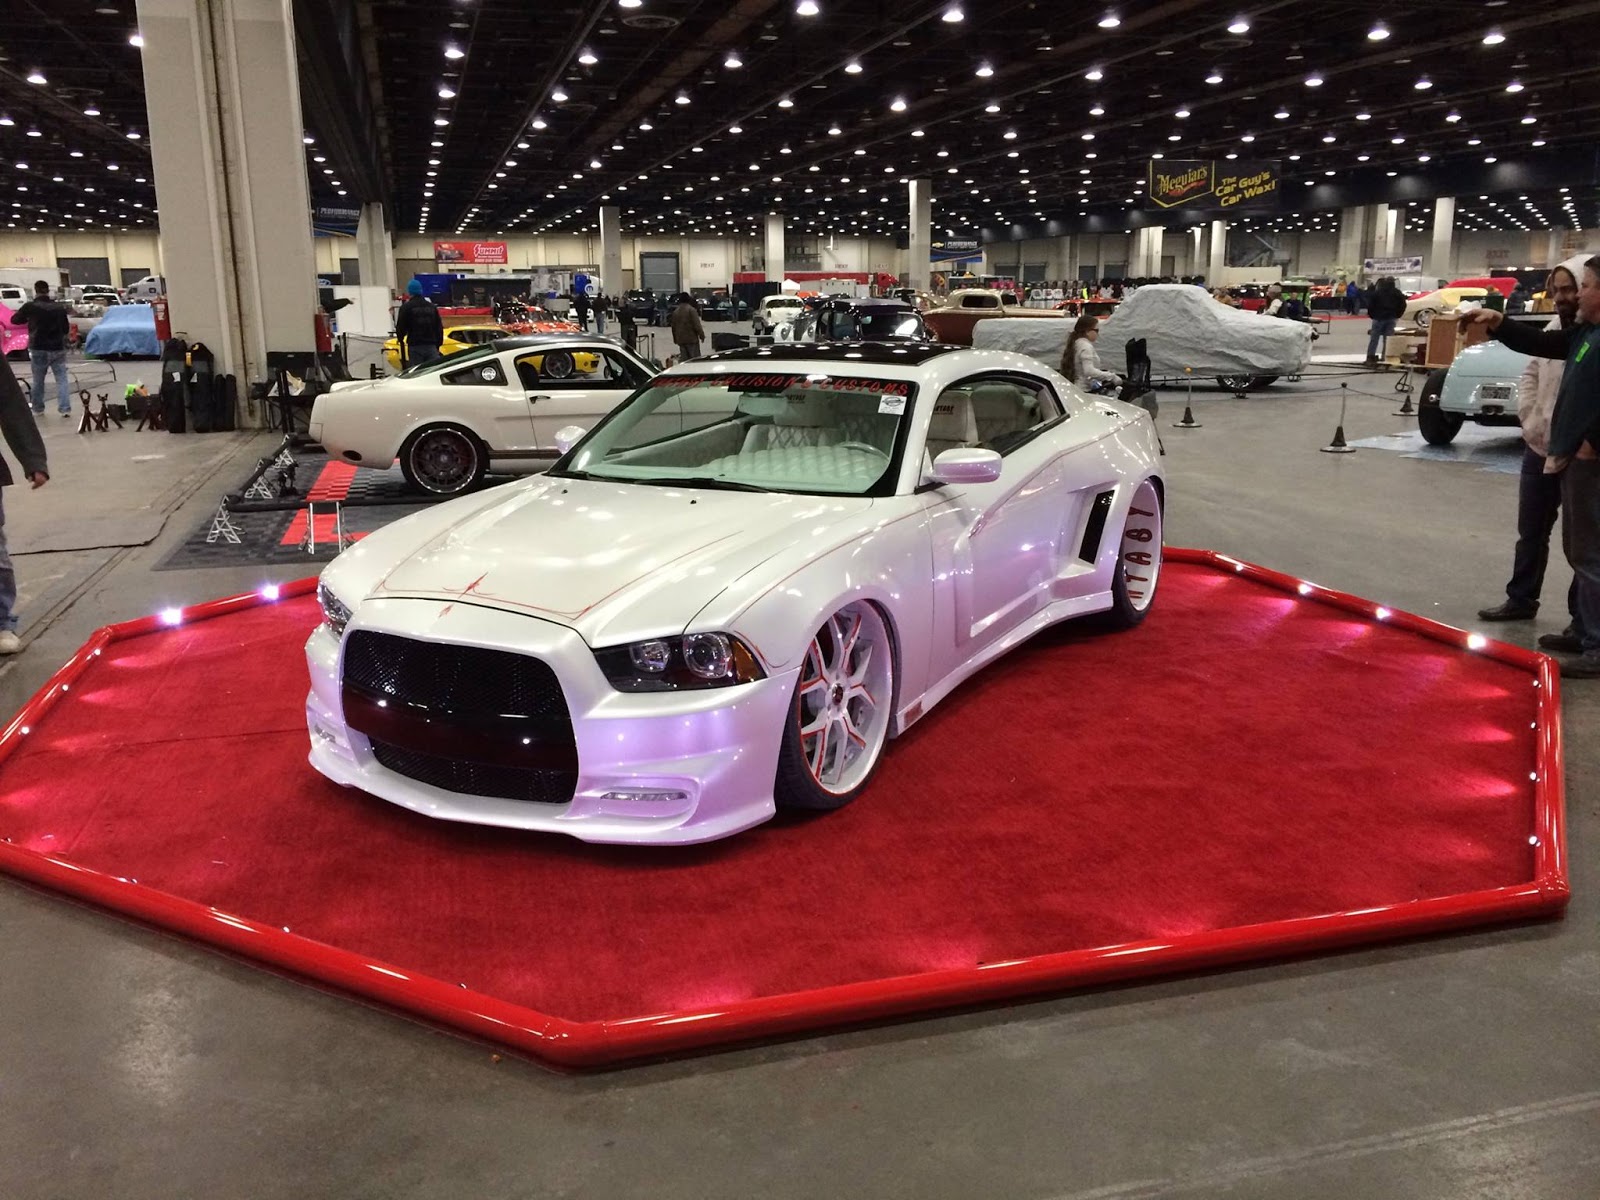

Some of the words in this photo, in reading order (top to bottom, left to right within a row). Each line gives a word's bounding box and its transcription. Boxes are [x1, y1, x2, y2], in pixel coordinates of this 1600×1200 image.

[1215, 183, 1237, 197] Car
[1238, 171, 1271, 189] Guy's
[1222, 176, 1237, 186] The
[1220, 193, 1242, 207] Car
[819, 378, 908, 397] CUSTOMS
